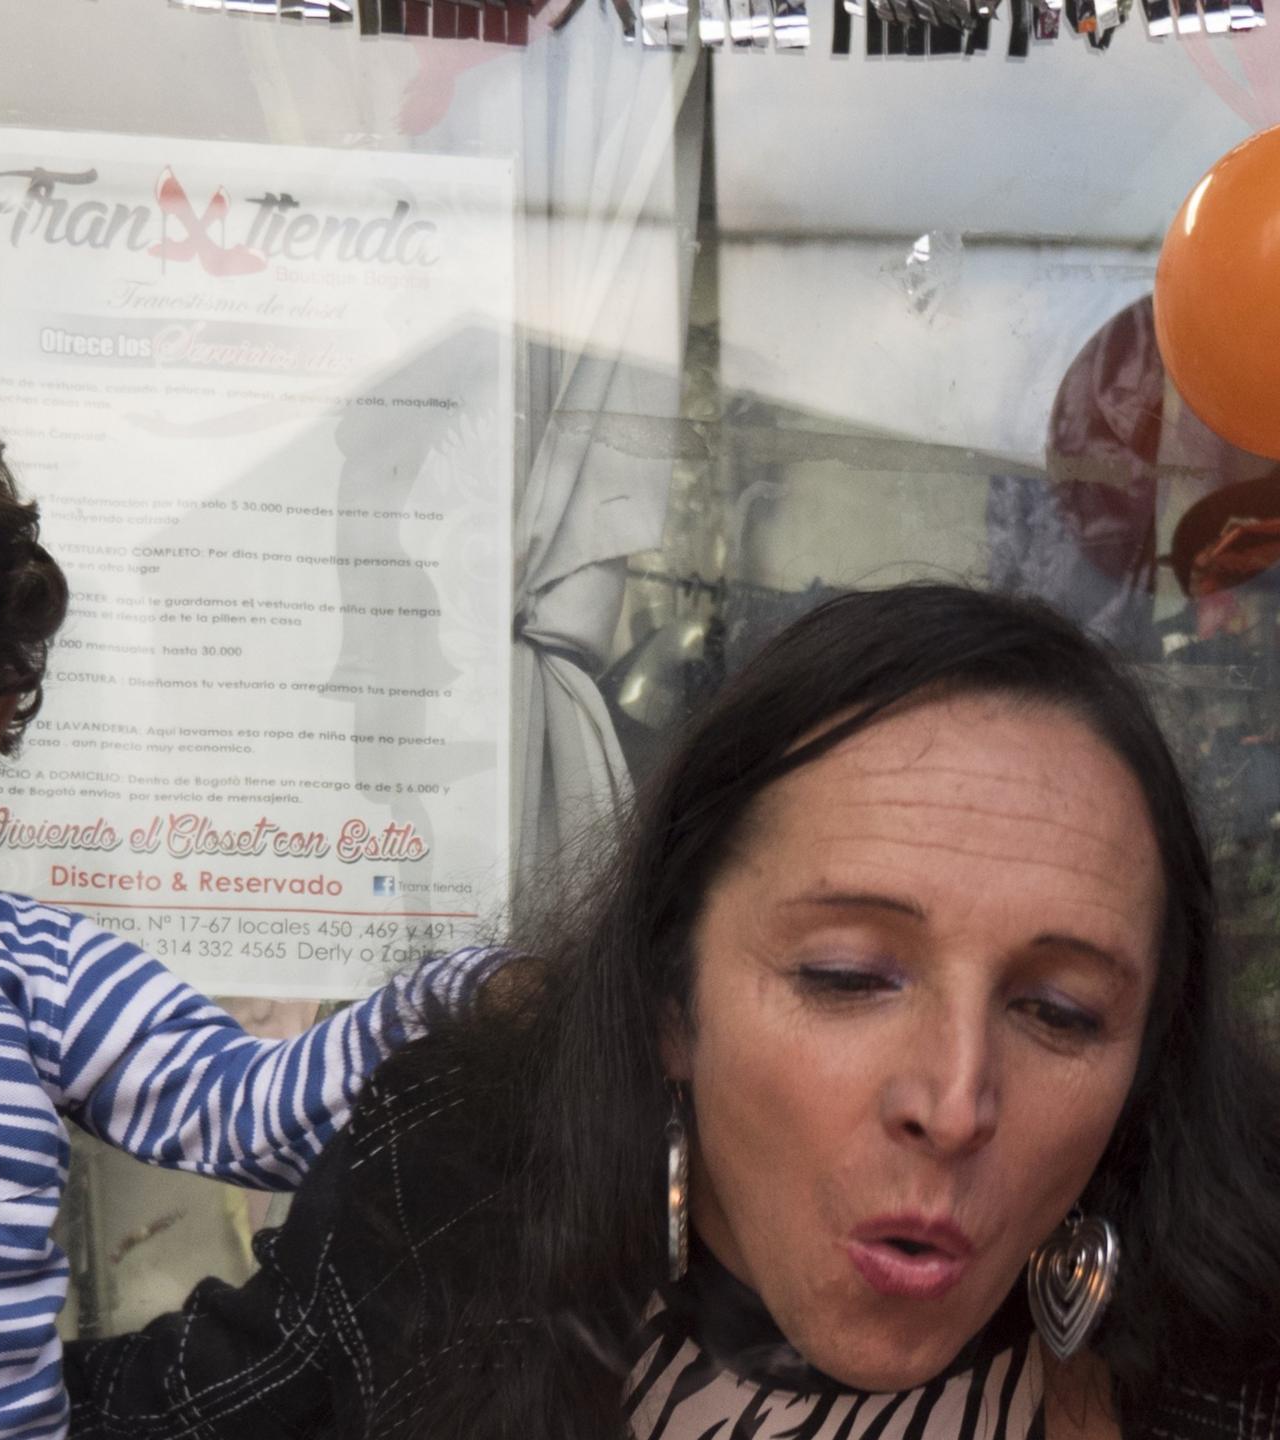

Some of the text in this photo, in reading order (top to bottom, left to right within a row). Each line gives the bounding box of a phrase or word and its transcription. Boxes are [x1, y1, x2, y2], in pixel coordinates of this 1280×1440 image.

[40, 327, 114, 356] Ofrece
[118, 334, 152, 358] los
[391, 394, 459, 412] maquillaje
[241, 501, 283, 515] 30.000
[285, 503, 334, 520] puedes
[336, 506, 369, 519] verte
[372, 509, 411, 521] como
[413, 508, 445, 522] toda
[207, 547, 229, 561] Por
[261, 553, 293, 566] para
[295, 551, 351, 568] aquellas
[353, 556, 412, 570] personas
[414, 558, 440, 571] que
[158, 609, 177, 623] de
[180, 611, 193, 623] te
[249, 616, 267, 627] en
[269, 617, 303, 628] casa
[164, 593, 239, 612] guardamos
[241, 596, 256, 610] el
[257, 597, 316, 613] vestuario
[318, 600, 336, 613] de
[339, 601, 367, 615] niña
[369, 605, 395, 618] que
[397, 603, 443, 621] tengas
[161, 642, 199, 656] hasta
[201, 643, 244, 658] 30.000
[56, 670, 118, 685] COSTURA
[127, 673, 199, 688] Diseñamos
[201, 677, 215, 689] tu
[217, 676, 276, 691] vestuario
[278, 682, 288, 692] o
[290, 679, 365, 698] arreglamos
[367, 683, 387, 696] tus
[389, 683, 441, 701] prendas
[35, 717, 54, 731] DE
[178, 723, 235, 739] lavamos
[236, 729, 262, 740] esa
[263, 731, 295, 744] ropa
[297, 729, 316, 742] de
[318, 730, 347, 744] niña
[349, 734, 376, 748] que
[377, 735, 397, 746] no
[398, 733, 448, 751] puedes
[99, 737, 144, 754] precio
[145, 742, 175, 755] muy
[7, 782, 26, 796] de
[128, 790, 152, 802] por
[153, 787, 205, 802] servicio
[206, 789, 225, 802] de
[127, 771, 171, 786] Dentro
[173, 773, 192, 786] de
[243, 775, 277, 789] tiene
[279, 779, 297, 790] un
[298, 780, 352, 794] recargo
[354, 779, 372, 792] de
[374, 779, 393, 793] de
[406, 780, 441, 794] 6.000
[129, 815, 164, 855] el
[166, 812, 276, 861] Closet
[273, 826, 332, 859] con
[335, 818, 431, 864] Estilo
[51, 865, 344, 897] Discreto & Reservado
[398, 880, 473, 895] Tranx tienda
[92, 911, 141, 932] ima.
[180, 916, 232, 934] 17-67
[238, 917, 311, 937] locales
[317, 921, 353, 939] 450
[406, 925, 418, 942] y
[423, 922, 455, 939] 491
[157, 939, 191, 957] 314
[198, 941, 233, 958] 332
[240, 943, 287, 961] 4565
[298, 942, 352, 965] Derly
[360, 948, 374, 962] o
